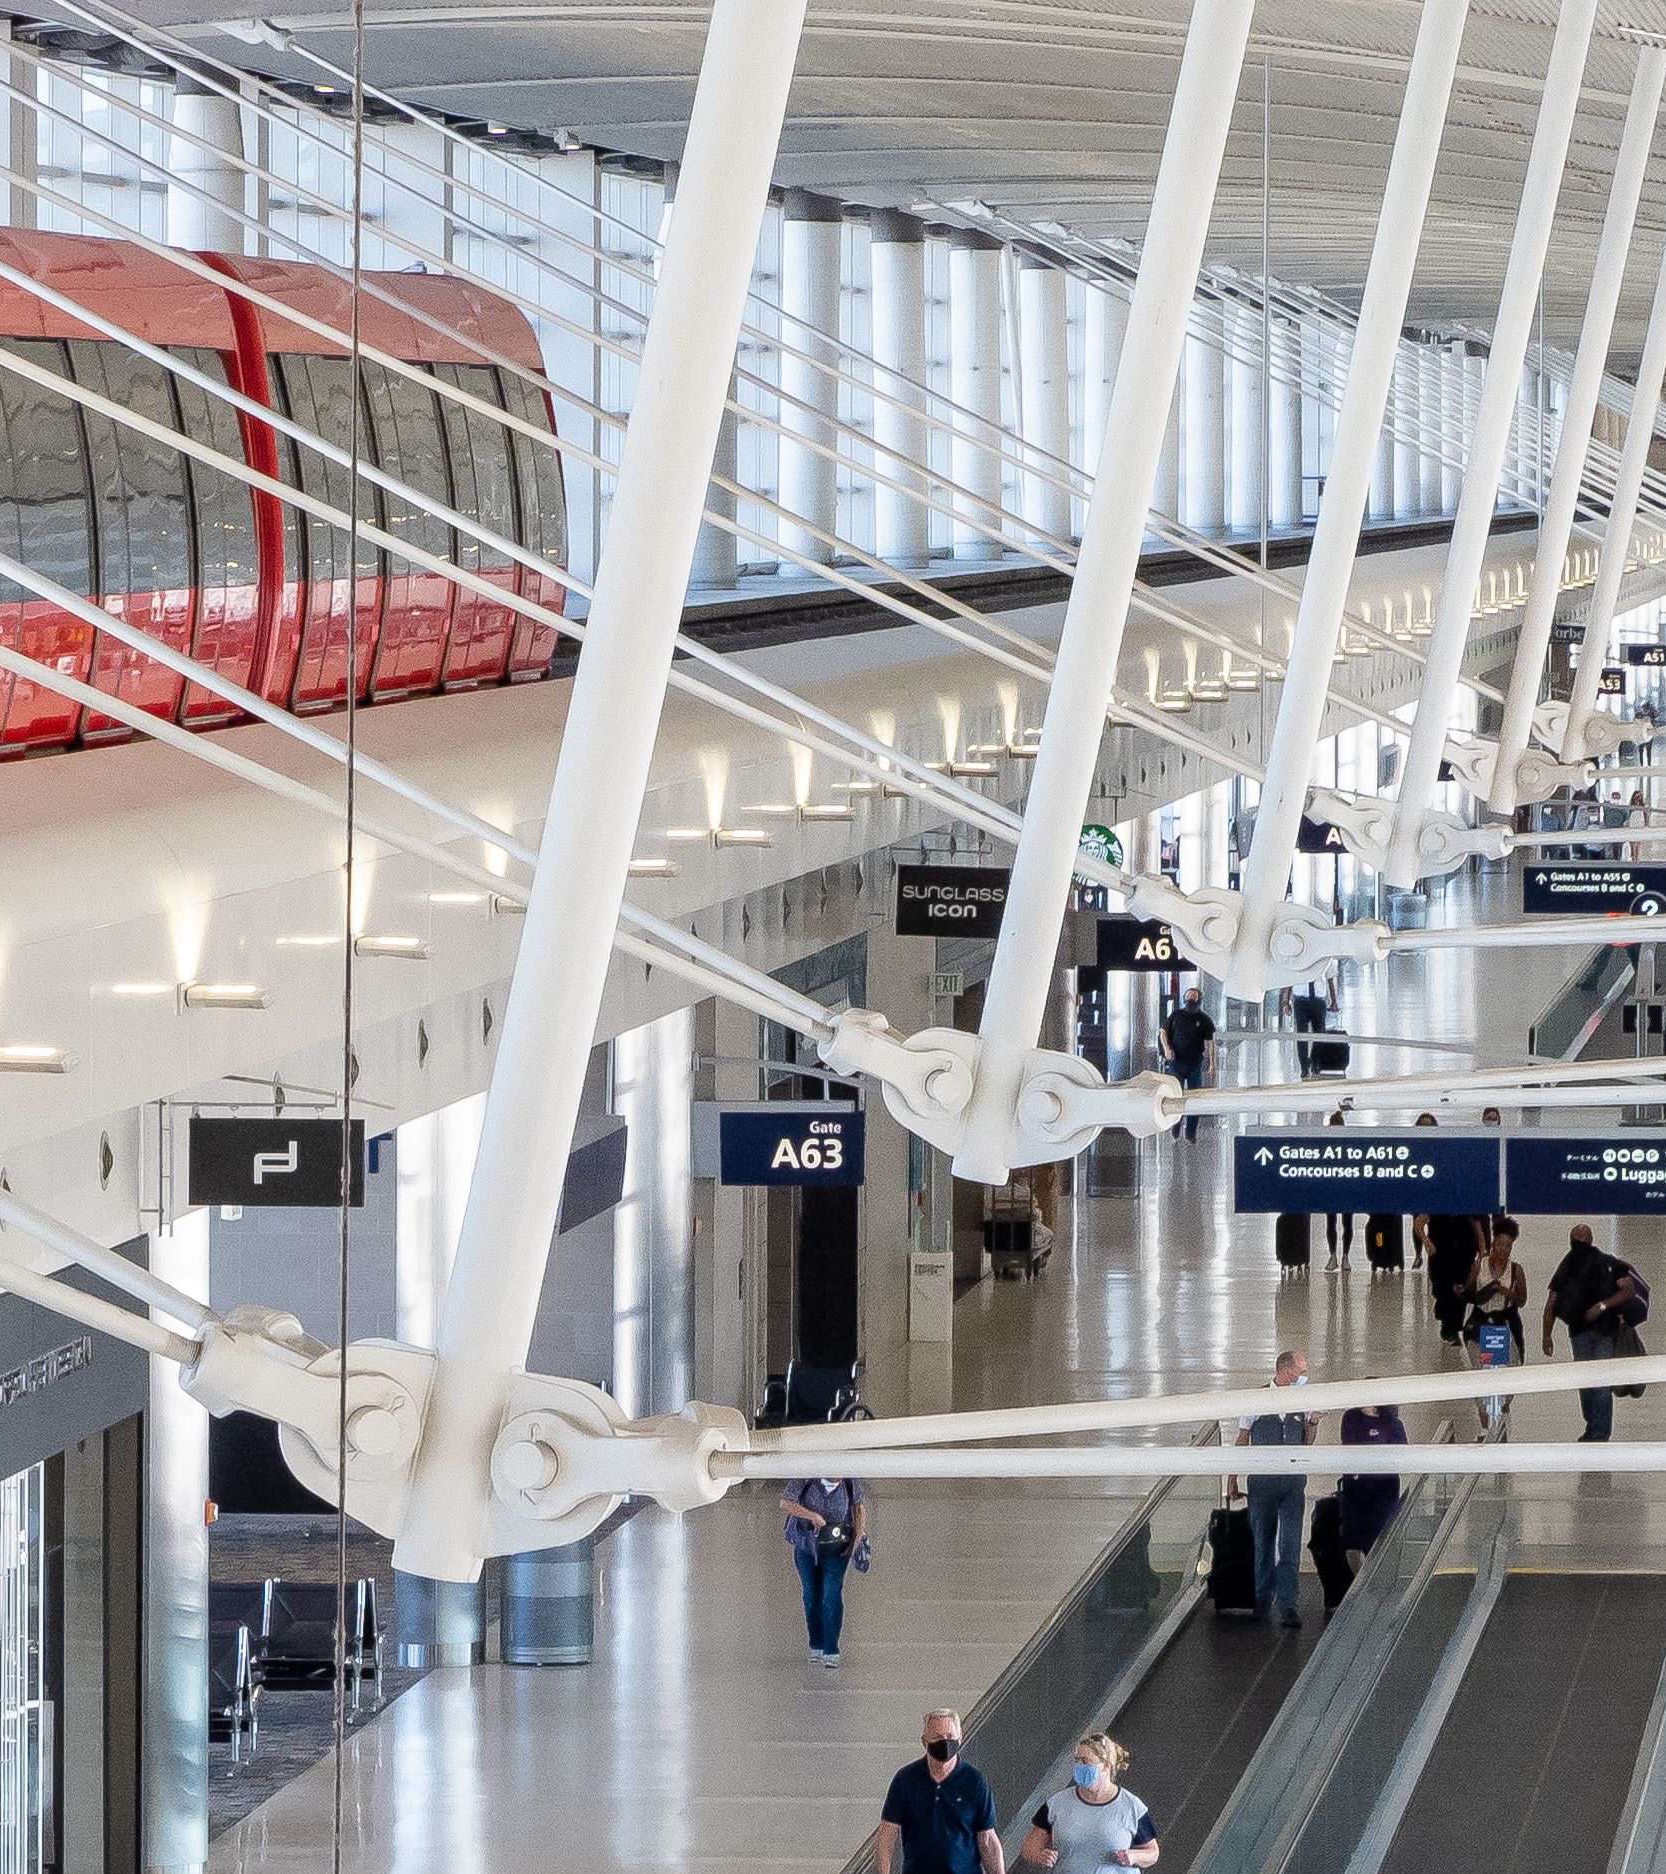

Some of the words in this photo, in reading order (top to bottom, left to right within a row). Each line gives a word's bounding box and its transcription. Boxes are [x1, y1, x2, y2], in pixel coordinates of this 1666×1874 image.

[1643, 651, 1665, 662] A51
[1550, 872, 1575, 881] Gates
[902, 885, 1005, 902] SUNGLASS
[1550, 883, 1599, 892] Concourses
[1135, 938, 1184, 960] A6
[809, 1121, 842, 1134] Gate
[771, 1138, 843, 1169] A63
[1279, 1146, 1320, 1160] Gates
[1323, 1146, 1342, 1159] A1
[1346, 1147, 1362, 1159] to
[1366, 1146, 1393, 1160] A61
[1279, 1164, 1360, 1178] Concourses
[1363, 1165, 1374, 1178] B
[1376, 1165, 1404, 1178] and
[1407, 1165, 1418, 1178] C
